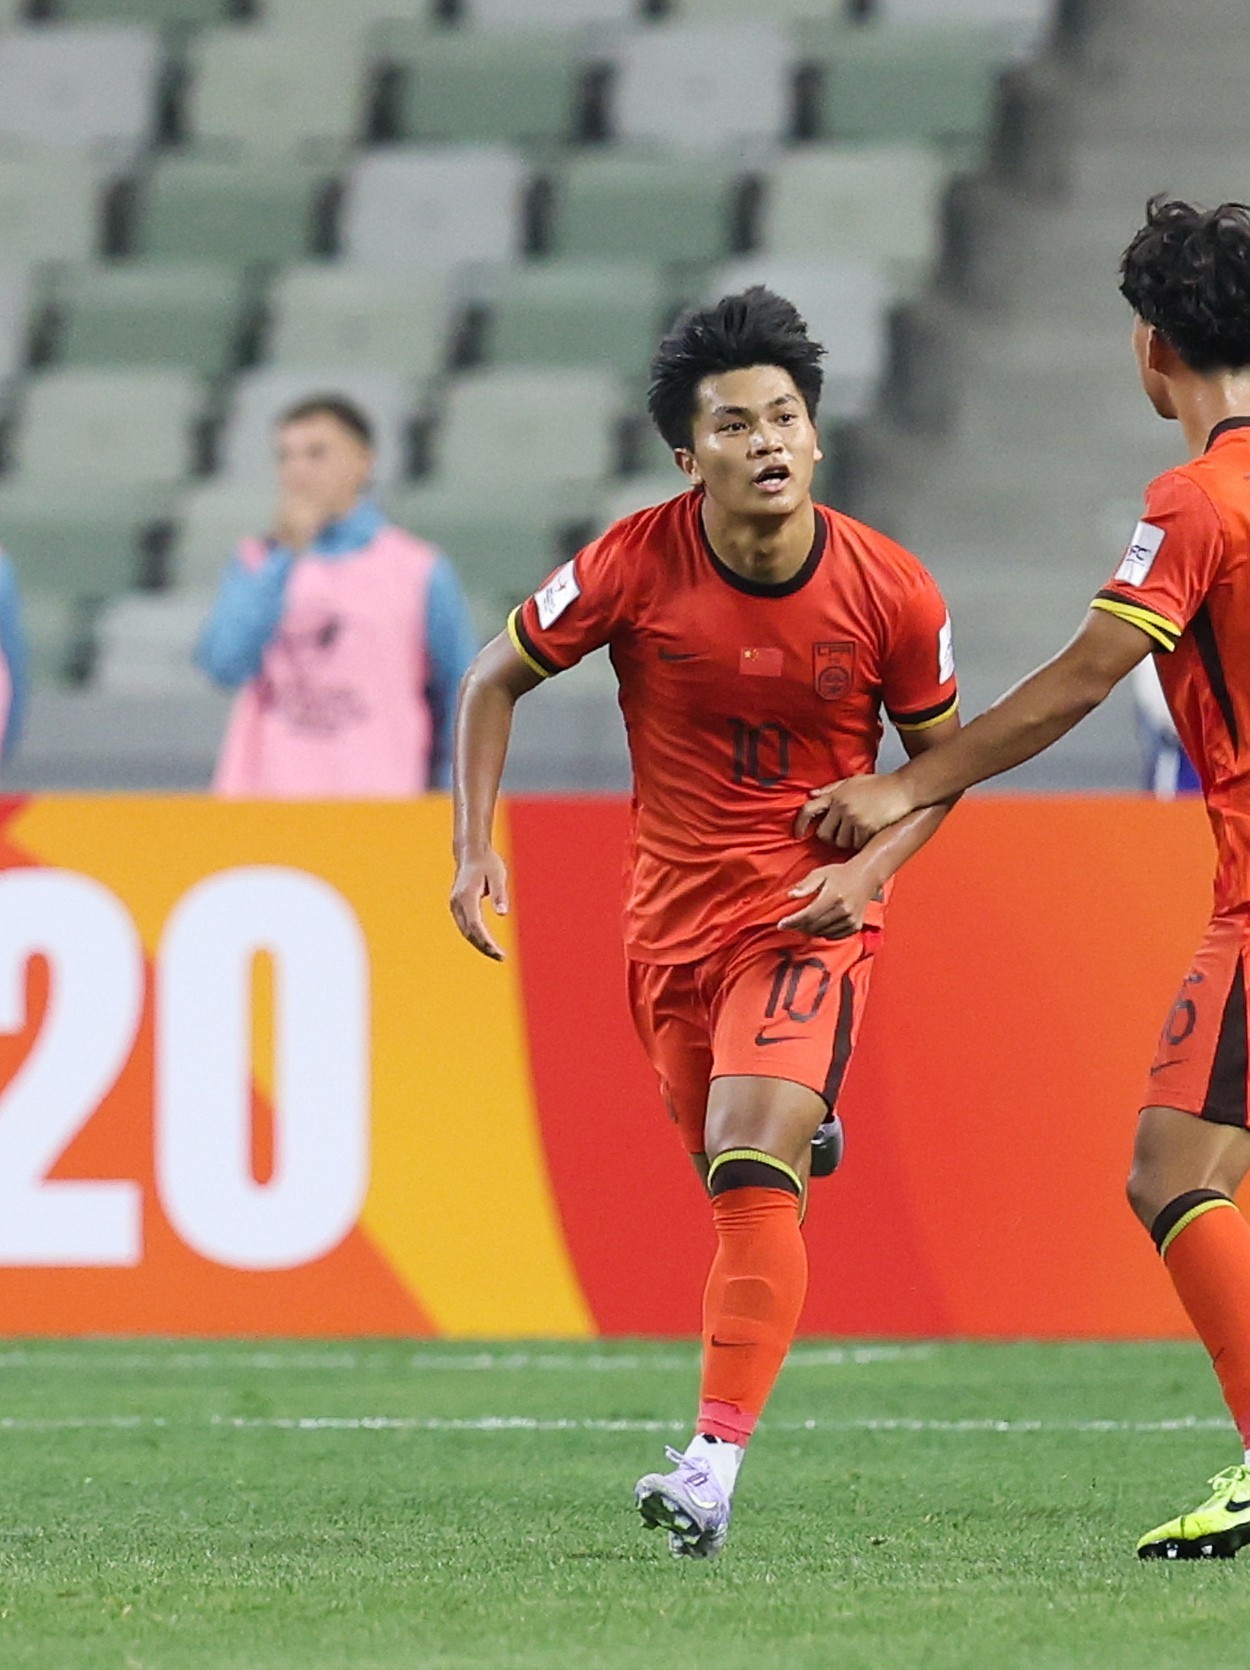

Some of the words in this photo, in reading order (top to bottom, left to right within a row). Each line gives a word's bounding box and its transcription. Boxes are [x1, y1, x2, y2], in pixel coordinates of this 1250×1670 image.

[728, 717, 790, 786] 10
[765, 948, 830, 1023] 10
[1164, 970, 1205, 1046] 6
[0, 865, 371, 1270] 20
